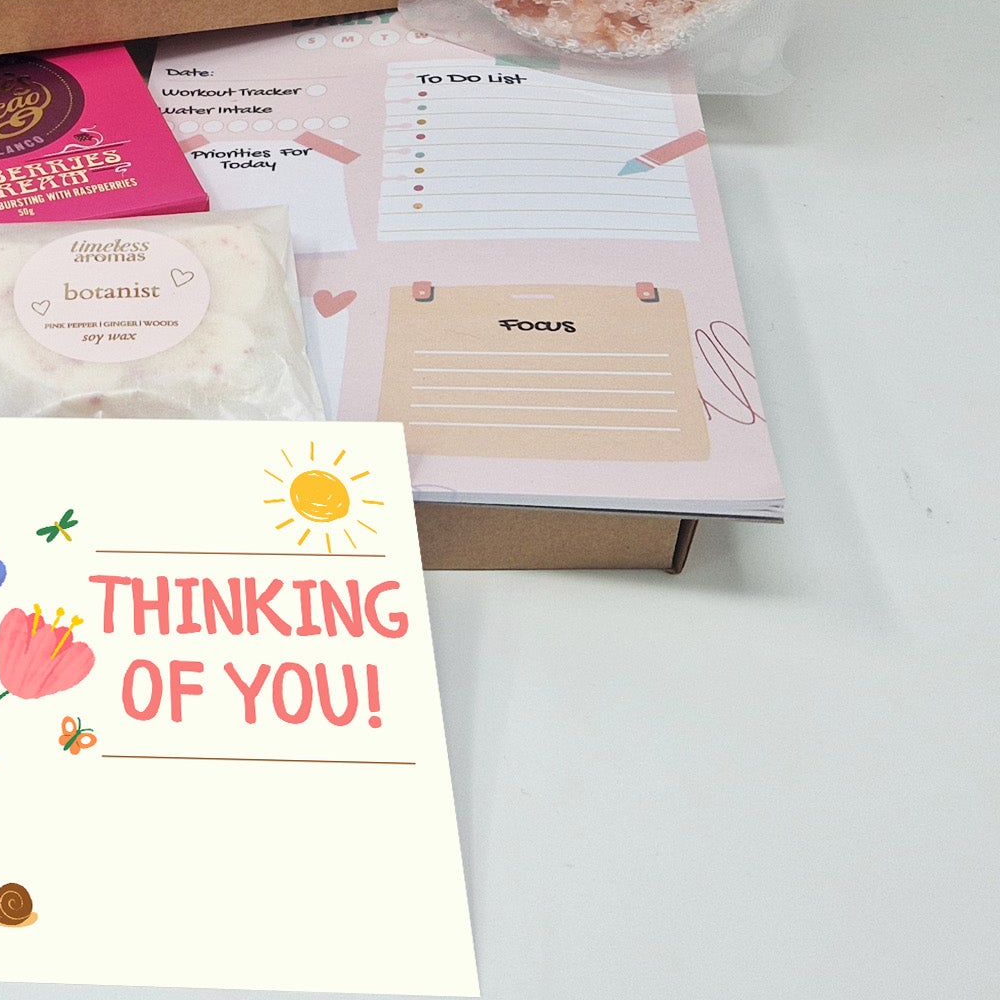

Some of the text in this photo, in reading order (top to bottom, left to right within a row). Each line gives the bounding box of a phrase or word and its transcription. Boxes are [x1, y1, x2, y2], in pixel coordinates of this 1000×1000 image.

[165, 68, 215, 77] Date:
[416, 73, 528, 84] To Do List
[162, 87, 302, 97] Workout Tracker
[158, 105, 273, 115] Water Intake
[191, 147, 313, 160] Priorities For
[220, 159, 277, 172] Today
[46, 188, 72, 202] WITH
[73, 177, 138, 196] RASPBERRIES
[17, 207, 35, 217] 50g
[70, 238, 150, 253] timeless
[74, 252, 146, 263] aromas
[64, 282, 160, 301] botanist
[67, 321, 98, 329] PEPPER
[103, 320, 138, 328] GINGER
[142, 320, 179, 328] WOODS
[498, 319, 576, 333] Focus
[82, 332, 137, 345] soy wax
[89, 575, 409, 638] THINKING
[122, 659, 382, 729] OF YOU!
